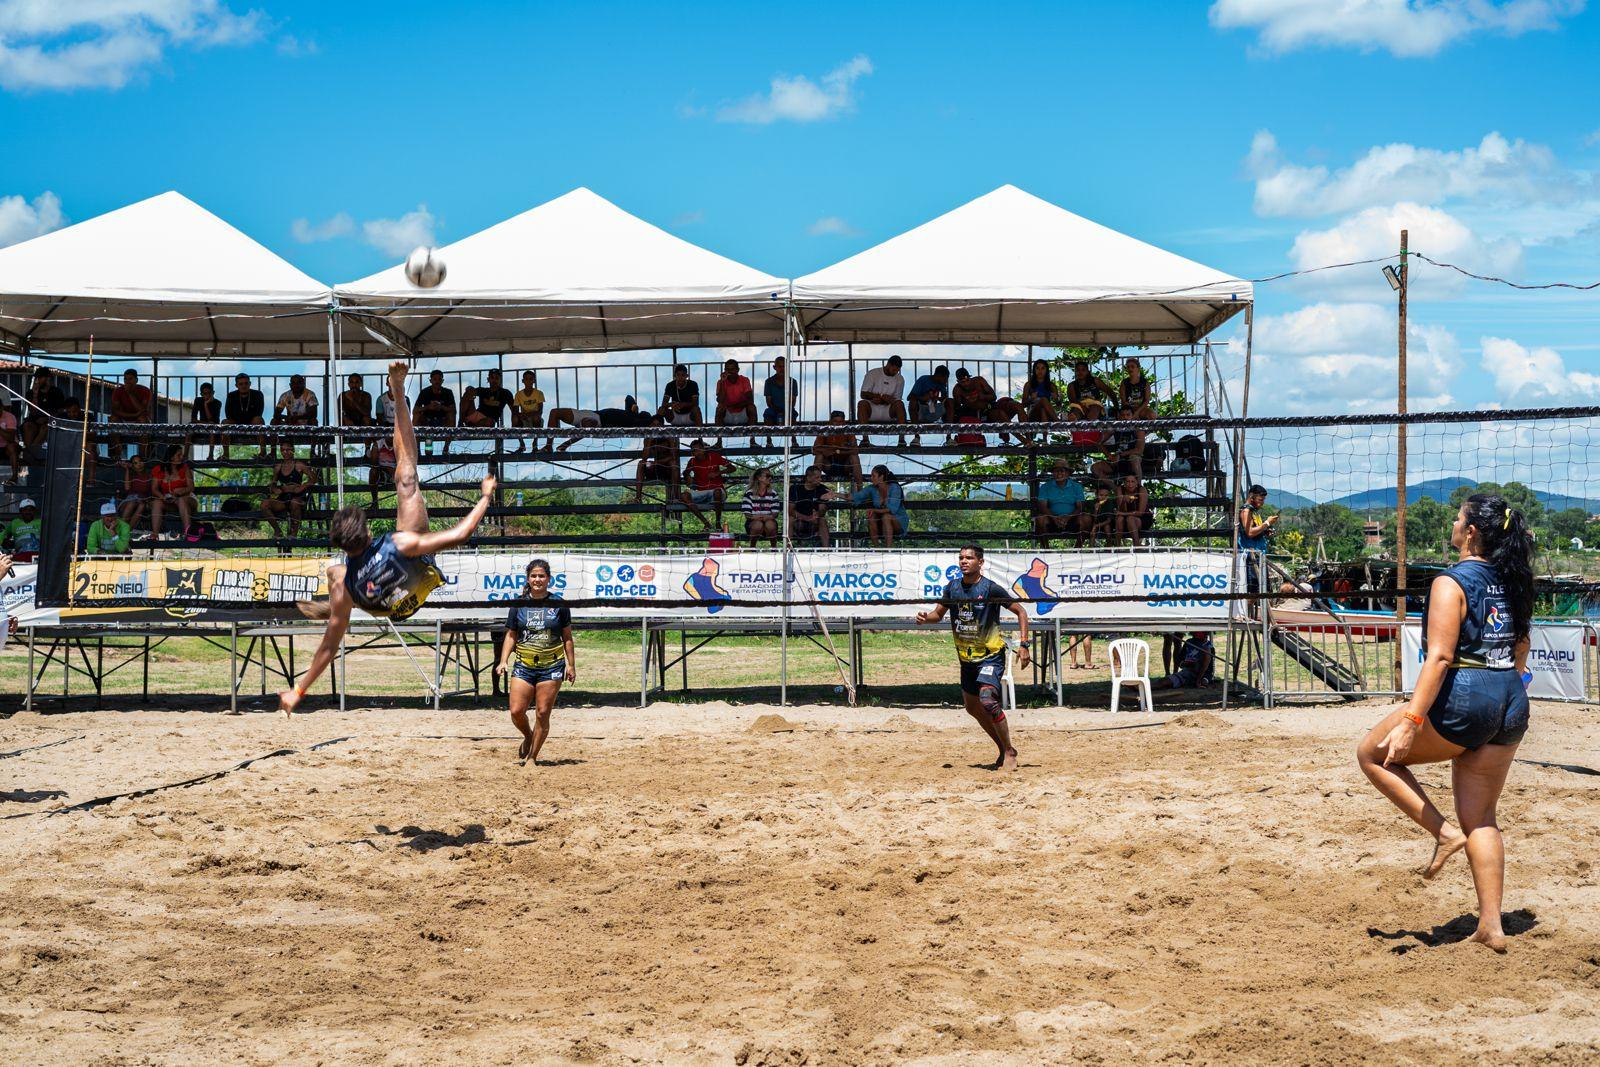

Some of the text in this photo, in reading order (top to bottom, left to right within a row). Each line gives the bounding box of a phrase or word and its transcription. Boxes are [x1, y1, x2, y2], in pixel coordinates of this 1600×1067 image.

[224, 570, 237, 586] RIO
[238, 568, 254, 587] SÃO
[283, 575, 306, 591] BATER
[484, 574, 567, 589] MAROS
[814, 573, 897, 588] MARCOS
[1057, 574, 1125, 584] TRAIPU
[1143, 574, 1228, 589] MARCOS
[4, 585, 36, 595] AIP
[91, 583, 143, 594] TORNEIO
[211, 585, 253, 601] FRANCISCO
[595, 584, 657, 597] PRO-CED
[1530, 649, 1575, 661] TRAIPU
